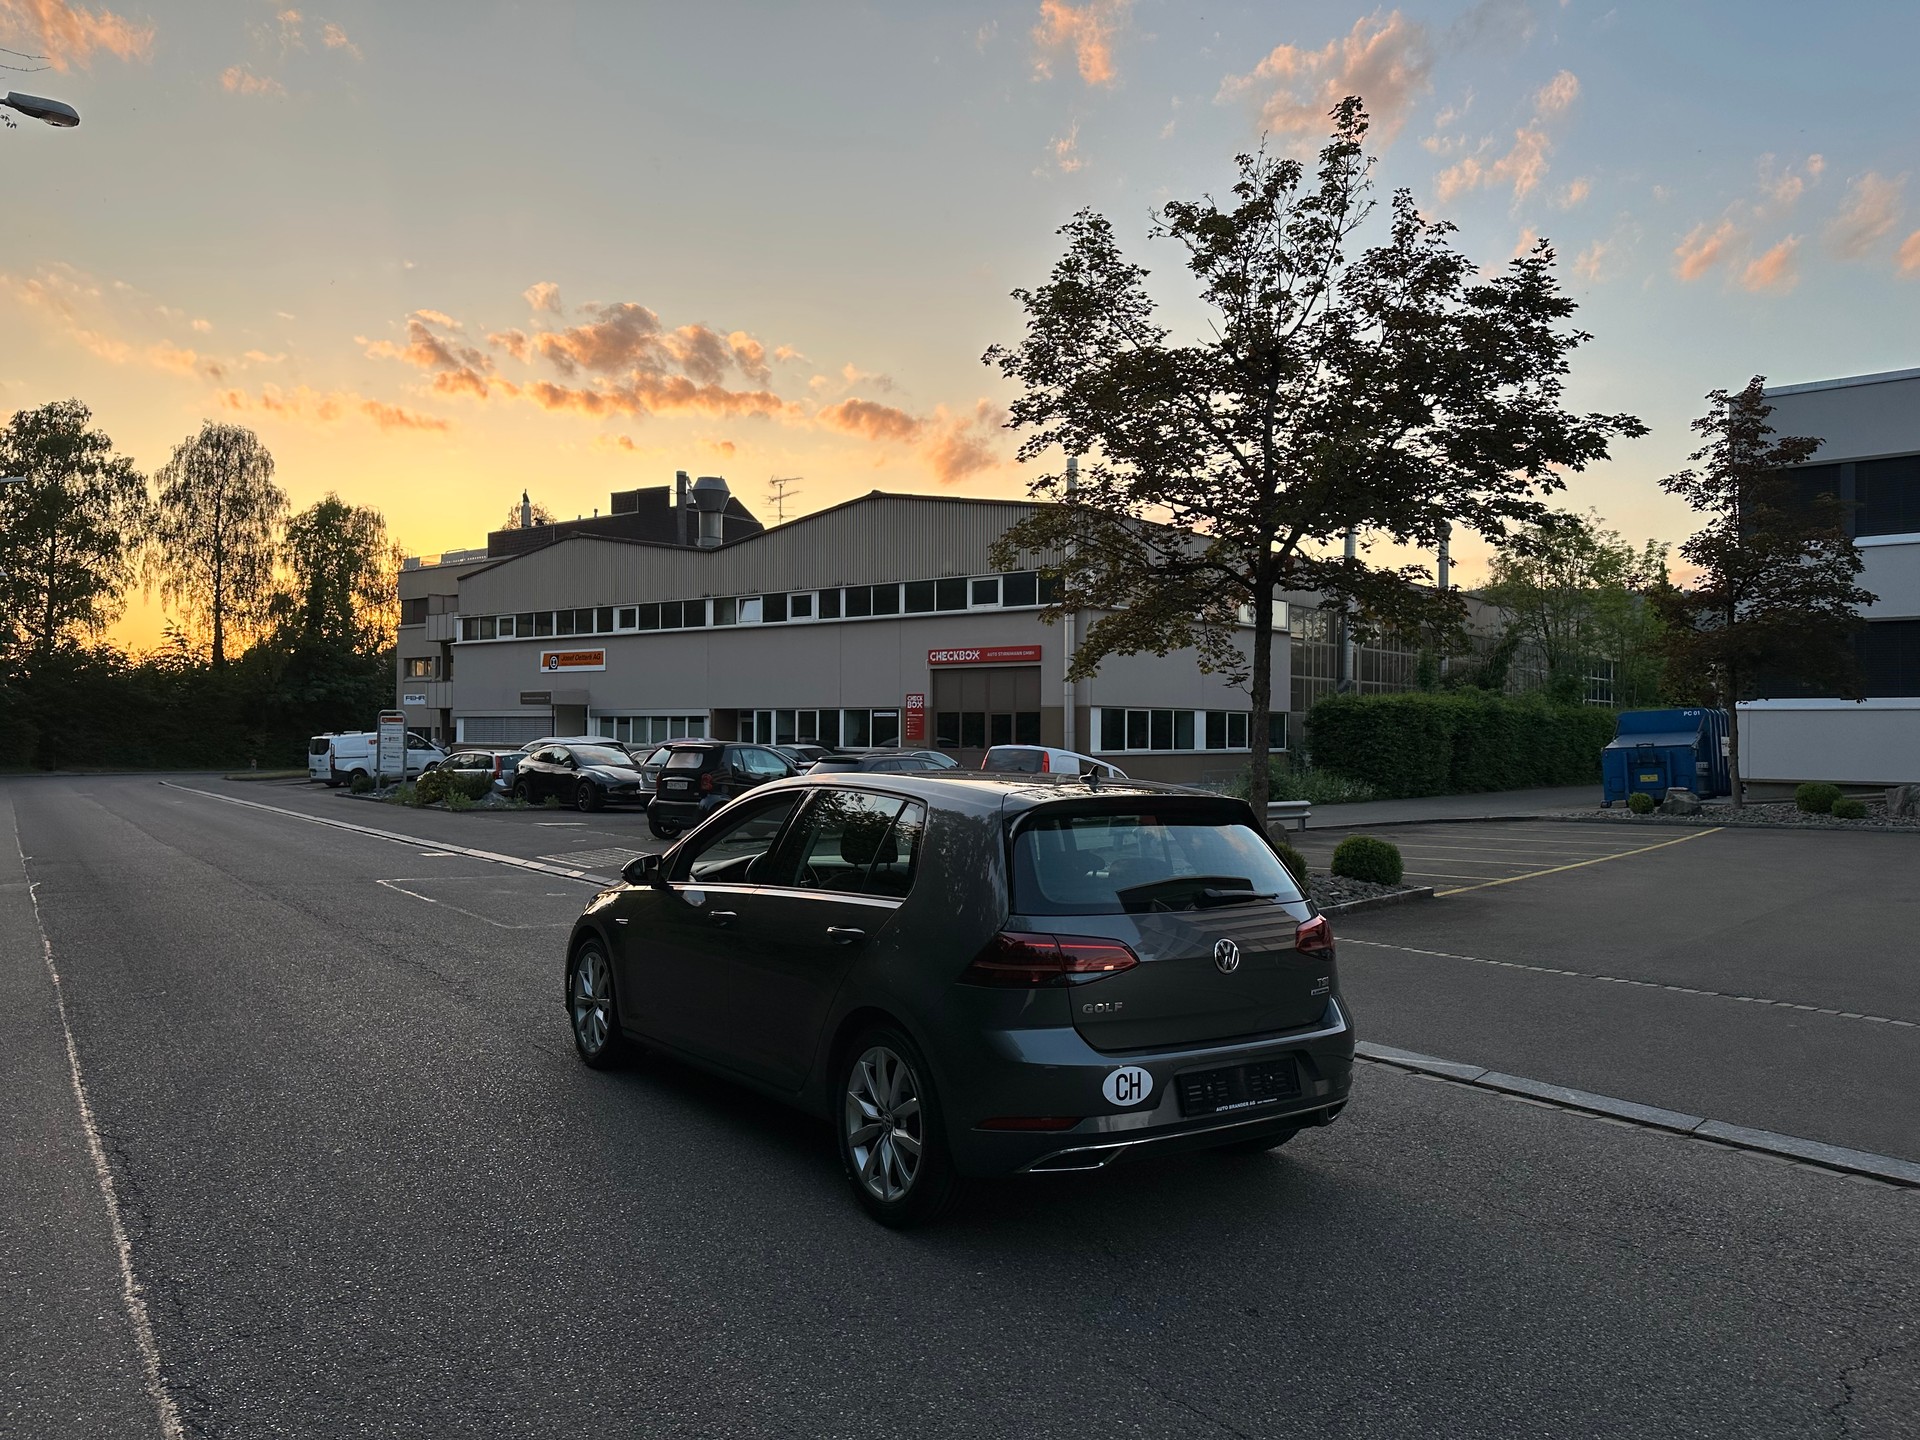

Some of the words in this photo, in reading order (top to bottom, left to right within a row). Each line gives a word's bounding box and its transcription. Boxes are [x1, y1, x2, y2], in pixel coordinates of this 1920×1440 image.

[930, 649, 981, 661] CHECKBOX
[1316, 976, 1329, 988] TSI
[1082, 1001, 1123, 1015] GOLF
[1115, 1071, 1142, 1102] CH
